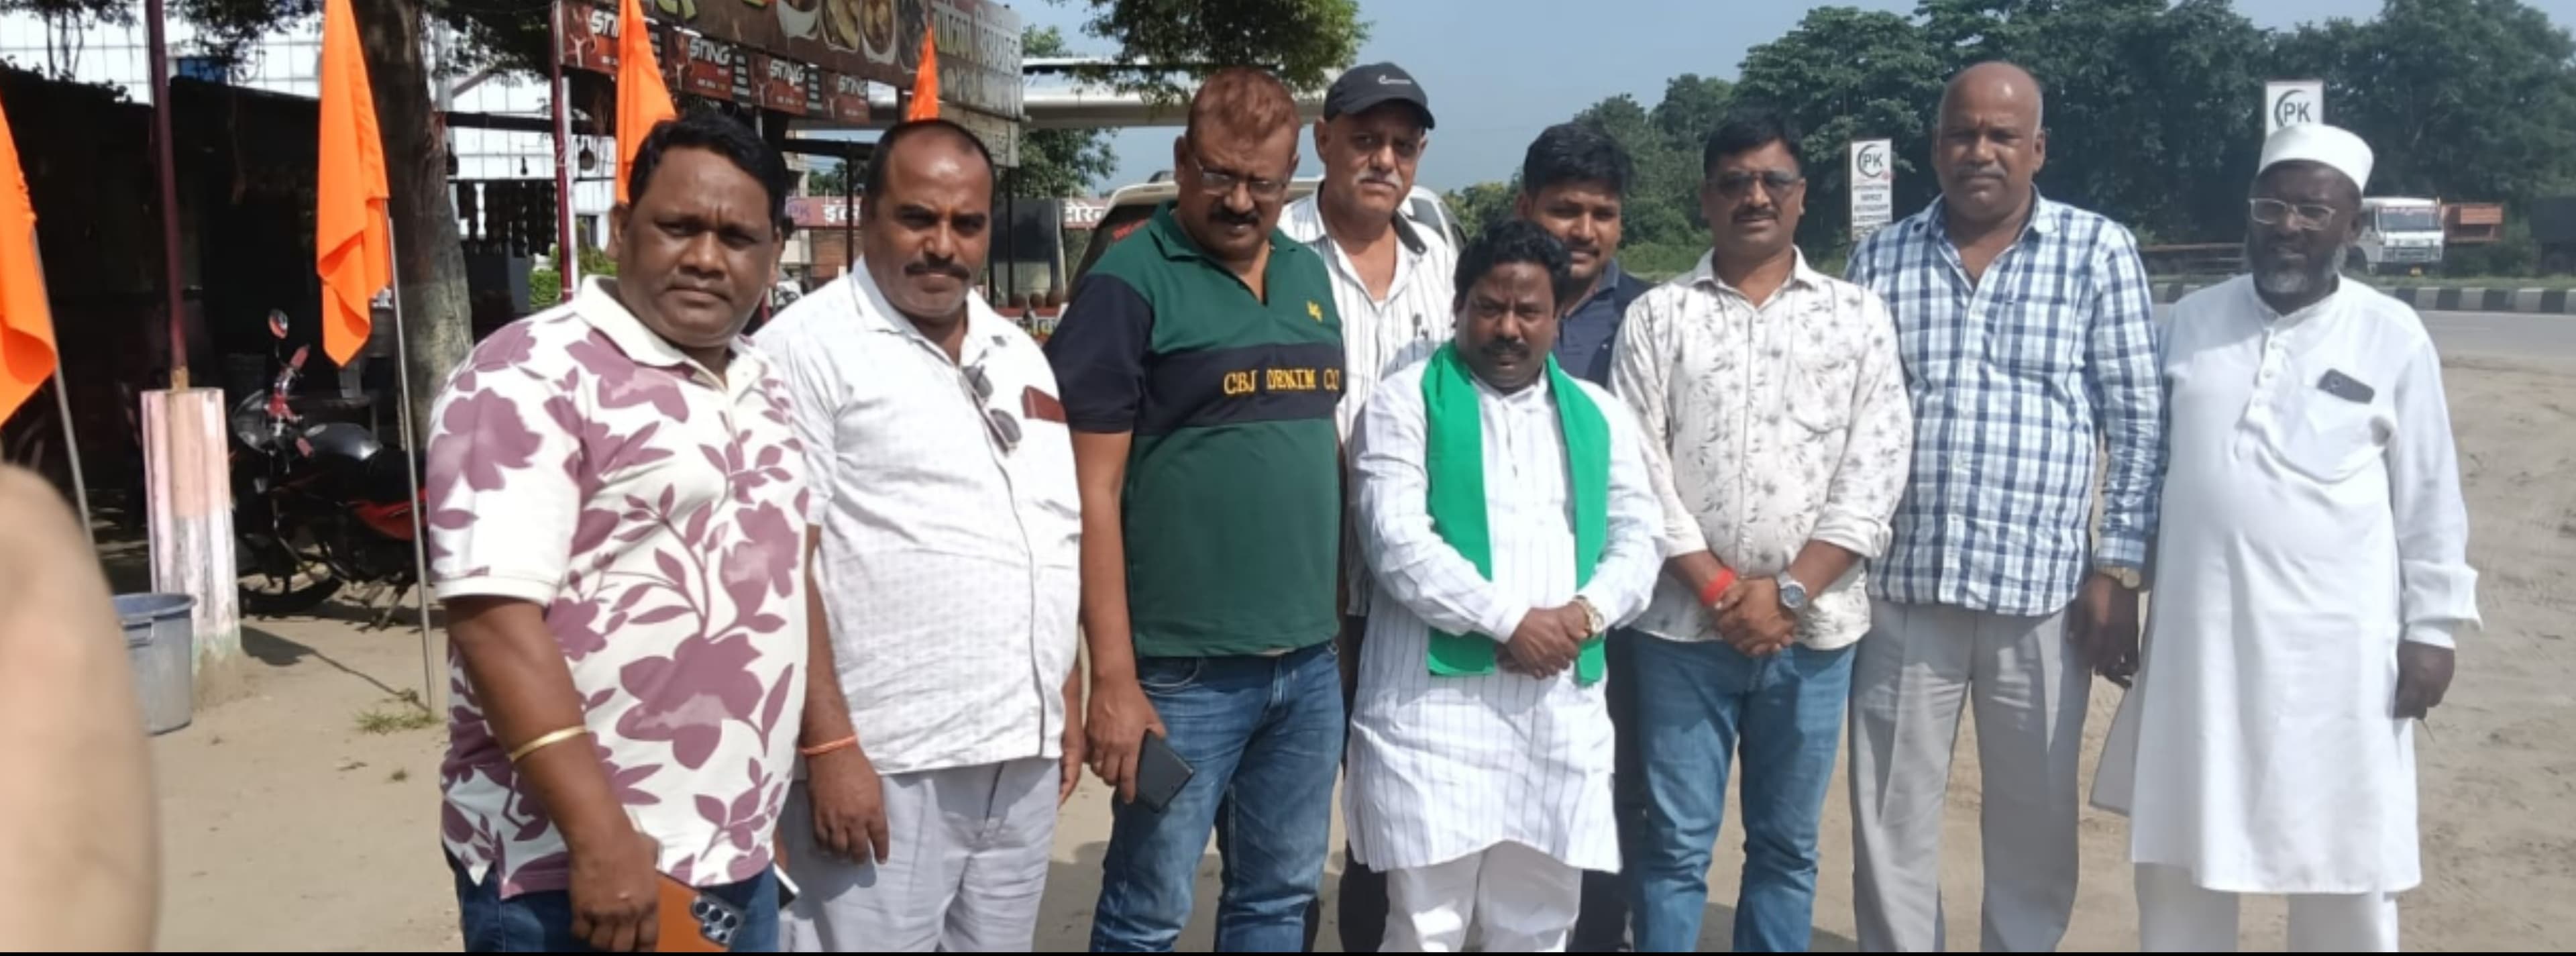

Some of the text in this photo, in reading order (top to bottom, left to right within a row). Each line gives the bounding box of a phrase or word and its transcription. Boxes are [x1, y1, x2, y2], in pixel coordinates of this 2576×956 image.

[689, 36, 731, 66] STING
[769, 58, 805, 84] STING
[2284, 101, 2311, 123] PK
[1862, 153, 1884, 168] PK
[1223, 370, 1258, 395] CBJ
[1266, 368, 1316, 390] DENIM
